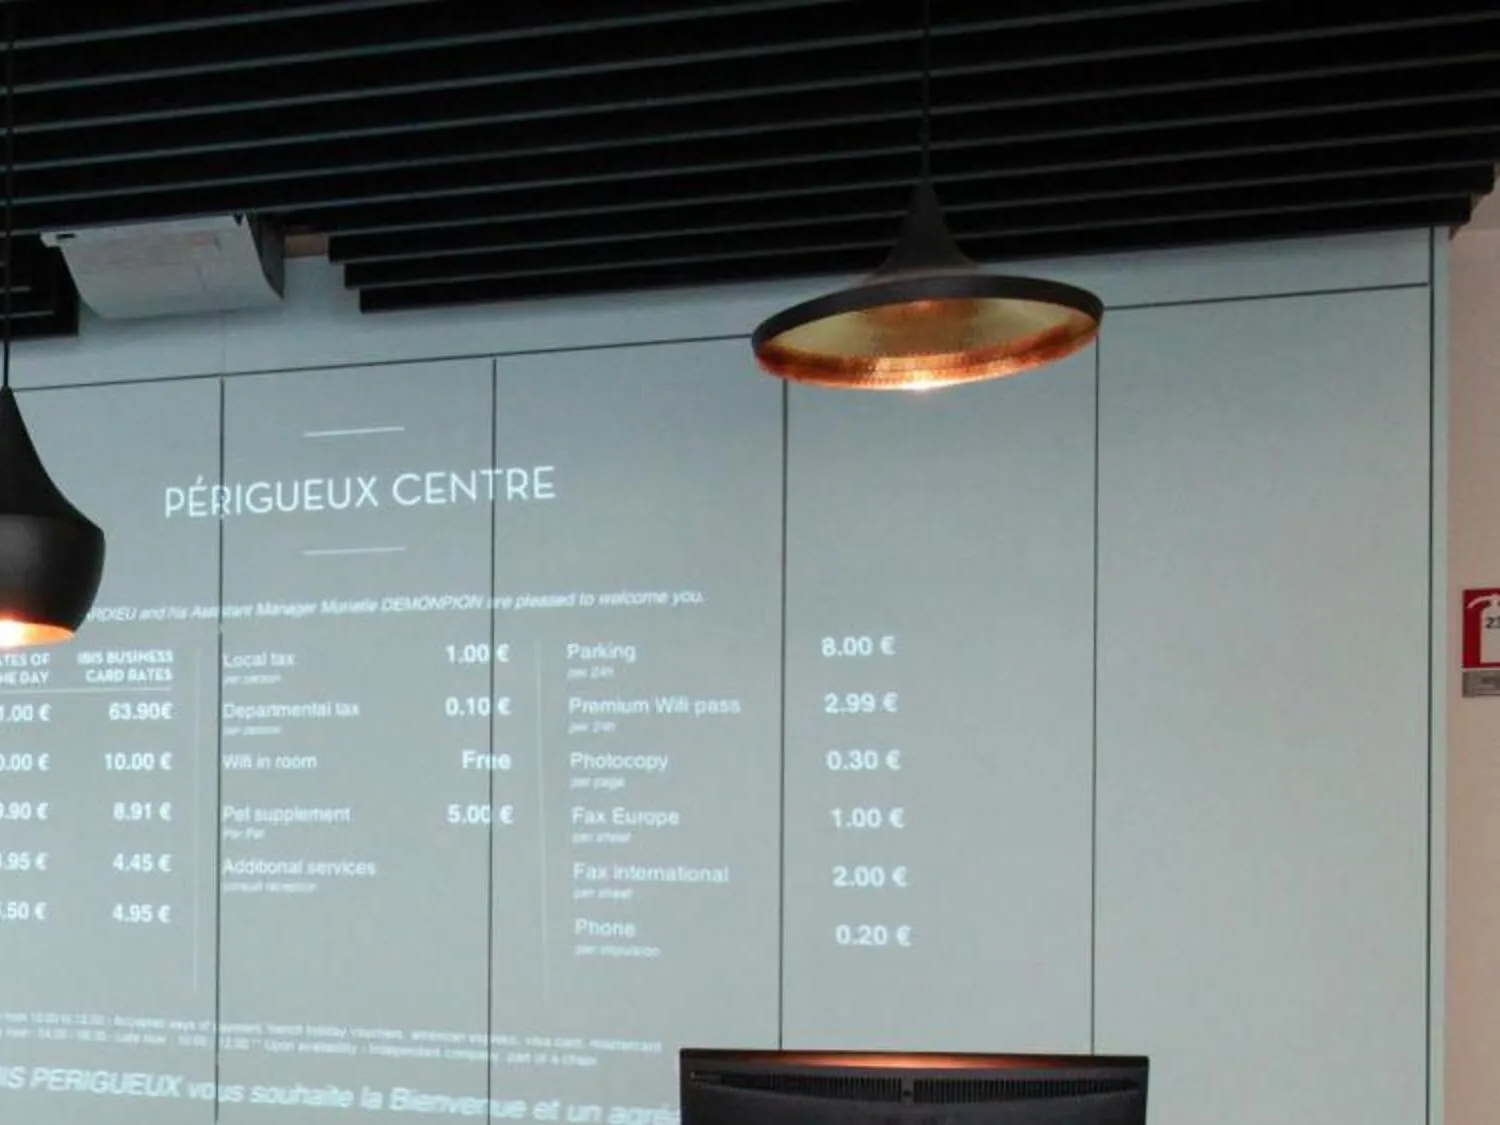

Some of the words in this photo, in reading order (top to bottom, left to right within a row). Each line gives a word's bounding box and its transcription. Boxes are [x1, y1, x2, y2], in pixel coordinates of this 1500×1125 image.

[164, 474, 379, 519] PÉRIGUEUX
[392, 465, 557, 507] CENTRE
[579, 593, 595, 608] to
[599, 591, 669, 607] welcome
[30, 653, 51, 667] OF
[77, 650, 104, 665] IBIS
[106, 649, 174, 664] BUSINESS
[222, 650, 267, 668] Local
[270, 652, 296, 667] tax
[445, 643, 490, 664] 1.00
[566, 643, 637, 664] Parking
[19, 670, 50, 685] DAY
[85, 668, 125, 683] CARD
[127, 667, 173, 682] RATES
[335, 701, 360, 717] tax
[444, 696, 490, 717] 0.10
[568, 697, 649, 715] Premium
[694, 700, 741, 718] pass
[823, 692, 876, 714] 2.99
[104, 753, 155, 771] 10.00
[256, 753, 271, 770] in
[275, 755, 318, 770] room
[569, 750, 670, 772] Photocopy
[826, 749, 879, 771] 0.30
[254, 806, 352, 824] supplement
[446, 803, 490, 824] 5.00
[571, 806, 606, 825] Fax
[612, 807, 680, 828] Europe
[830, 808, 883, 829] 1.00
[112, 853, 153, 872] 4.45
[306, 860, 378, 877] services
[573, 862, 608, 881] Fax
[831, 866, 886, 888] 2.00
[112, 904, 152, 923] 4.95
[574, 917, 637, 937] Phone
[834, 924, 888, 946] 0.20
[30, 1067, 185, 1098] PERIGUEUX
[187, 1083, 244, 1103] vous
[249, 1083, 353, 1109] souhaite
[360, 1085, 383, 1111] la
[389, 1086, 527, 1119] Bienvenue
[532, 1100, 560, 1121] et
[566, 1103, 601, 1123] un
